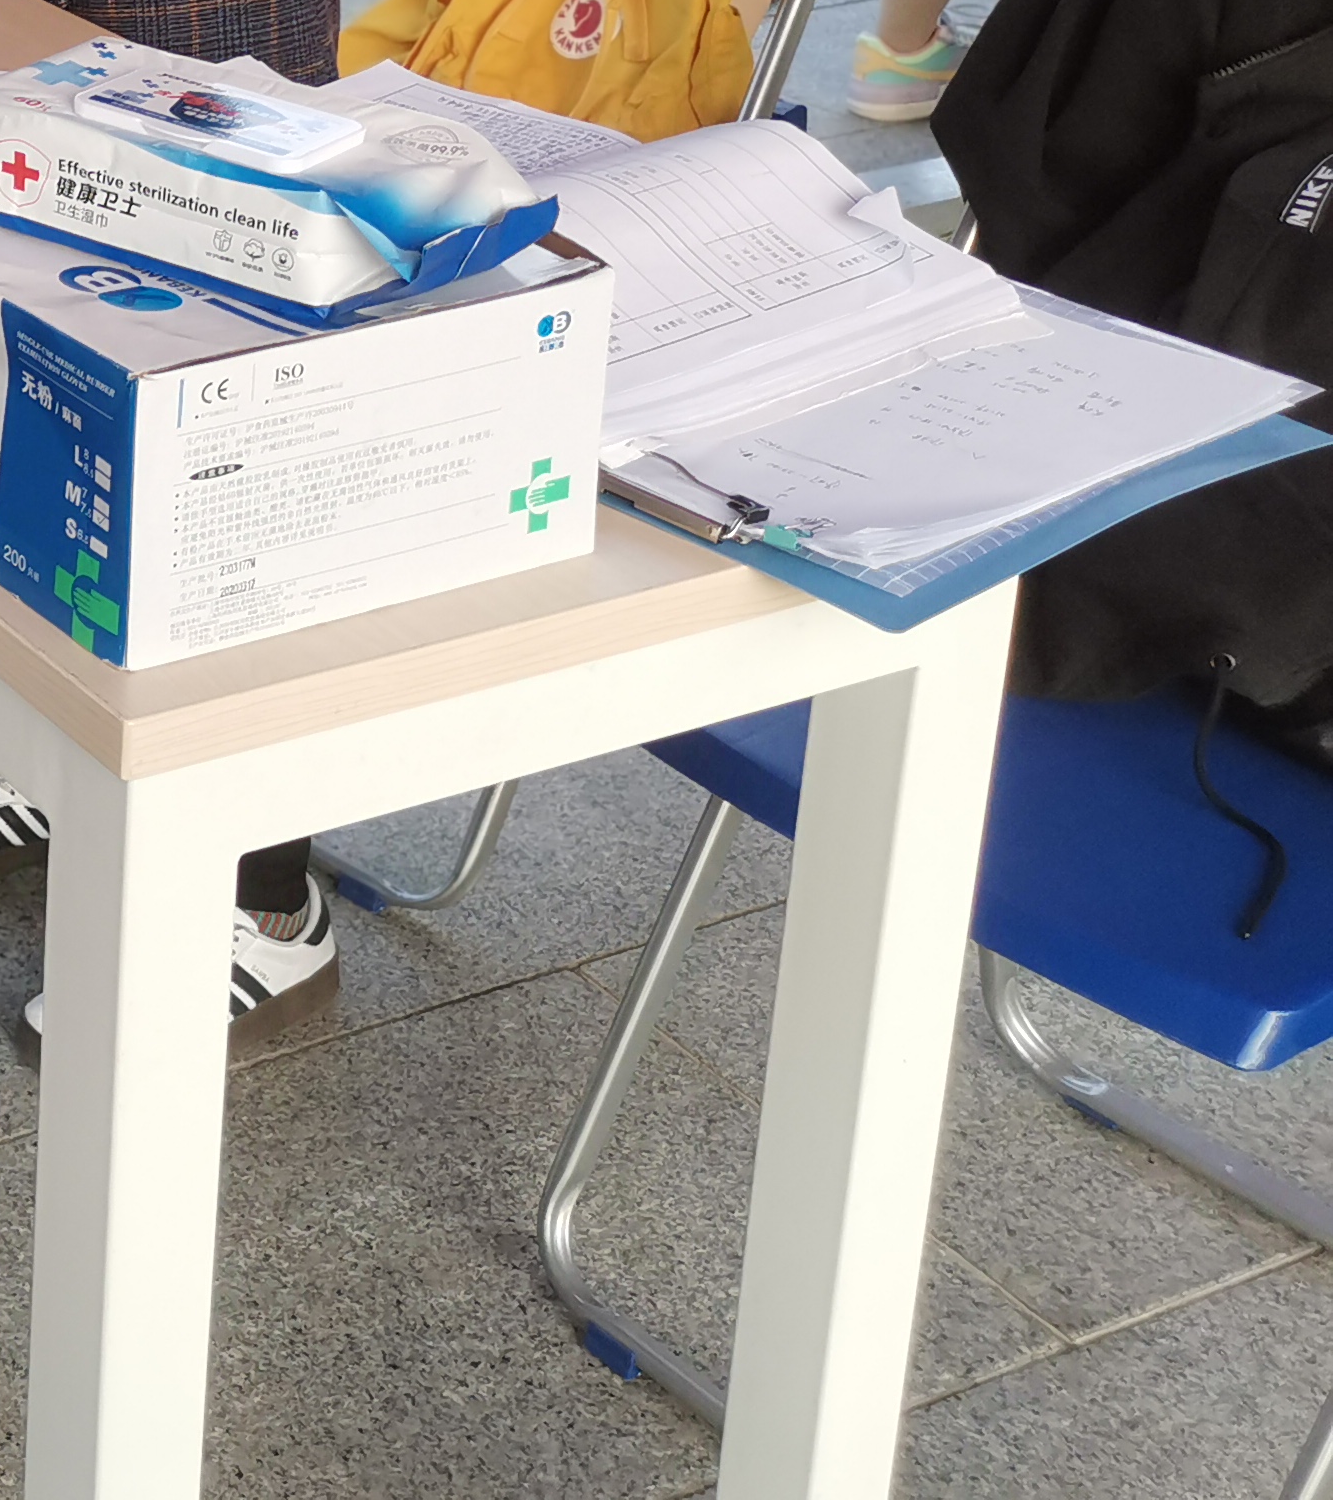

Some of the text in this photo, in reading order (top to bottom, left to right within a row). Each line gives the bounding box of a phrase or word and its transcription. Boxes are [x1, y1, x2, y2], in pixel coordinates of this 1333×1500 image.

[56, 176, 142, 219] 健康卫士
[58, 158, 300, 241] Effective sterilization clean life
[1286, 166, 1333, 227] NIKE
[53, 200, 109, 229] 卫生湿巾
[275, 363, 304, 382] ISO
[22, 370, 52, 410] 无粉
[201, 378, 230, 404] CE
[74, 444, 83, 468] L
[65, 479, 82, 507] M
[65, 517, 78, 539] S
[3, 544, 27, 572] 200
